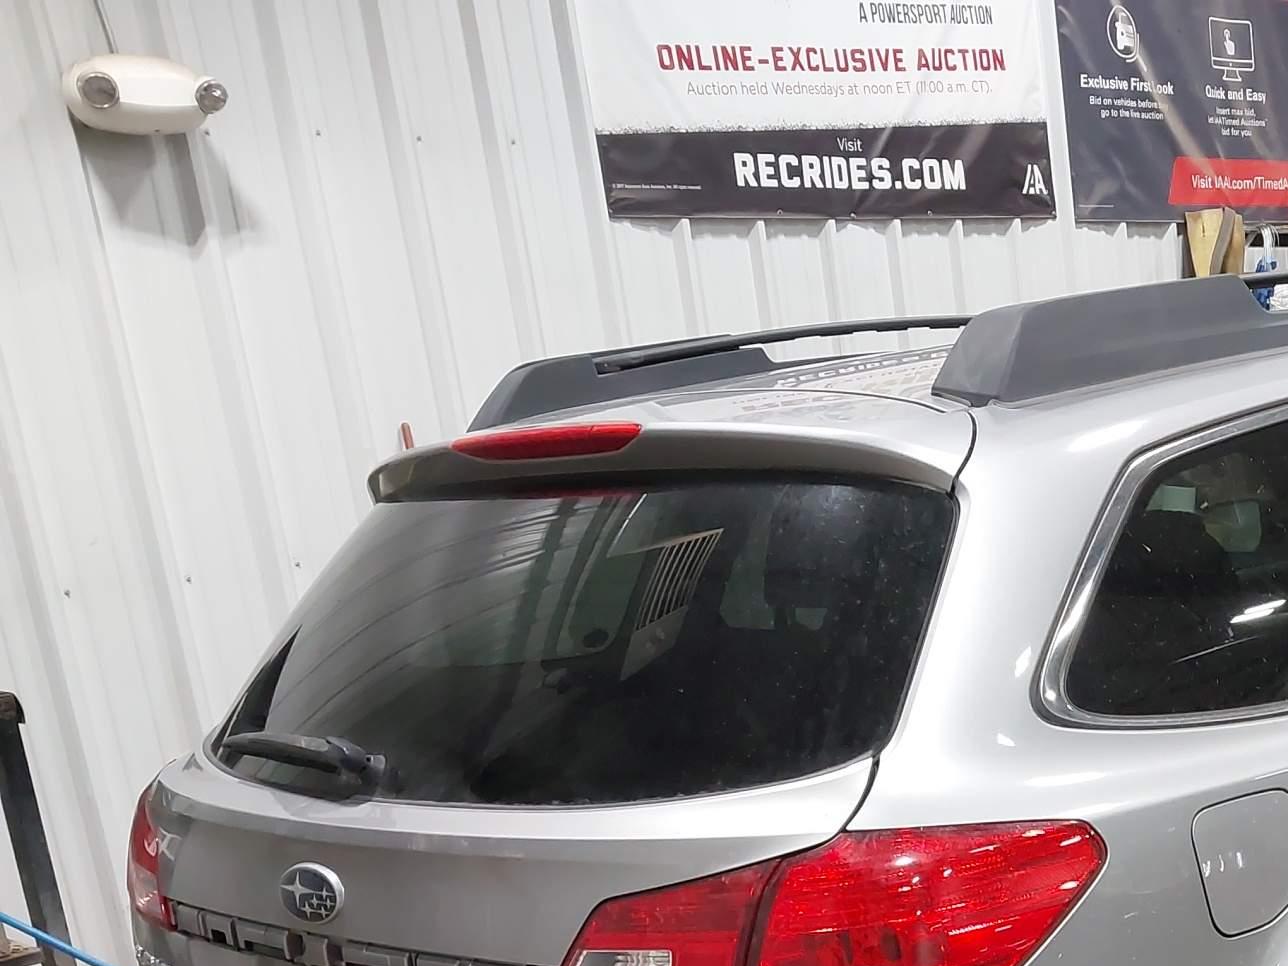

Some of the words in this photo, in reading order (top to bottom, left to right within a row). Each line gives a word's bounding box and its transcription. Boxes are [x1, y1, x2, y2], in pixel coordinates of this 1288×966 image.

[859, 2, 868, 23] A
[870, 2, 947, 24] POWERSPORT
[950, 4, 993, 25] AUCTION
[656, 44, 907, 73] ONLINE-EXCLUSIVE
[917, 48, 1006, 72] AUCTION
[687, 81, 738, 96] Auction
[740, 81, 768, 96] held
[771, 81, 845, 98] Wednesdays
[847, 83, 860, 96] at
[863, 83, 893, 95] noon
[896, 81, 911, 94] ET
[971, 80, 993, 95] CT).
[1080, 73, 1129, 91] Exclusive
[1130, 77, 1152, 92] First
[1089, 95, 1102, 106] Bid
[1103, 97, 1113, 106] on
[1113, 98, 1137, 108] vehicles
[1205, 84, 1226, 100] Quick
[1227, 87, 1244, 101] and
[1245, 88, 1267, 105] Easy
[1100, 108, 1110, 119] go
[1111, 109, 1118, 118] to
[1119, 109, 1130, 118] the
[1130, 109, 1140, 119] live
[1141, 110, 1165, 121] auction
[1231, 127, 1240, 136] for
[837, 137, 863, 152] Visit
[733, 152, 967, 190] RECRIDES.COM
[1191, 174, 1212, 189] Visit
